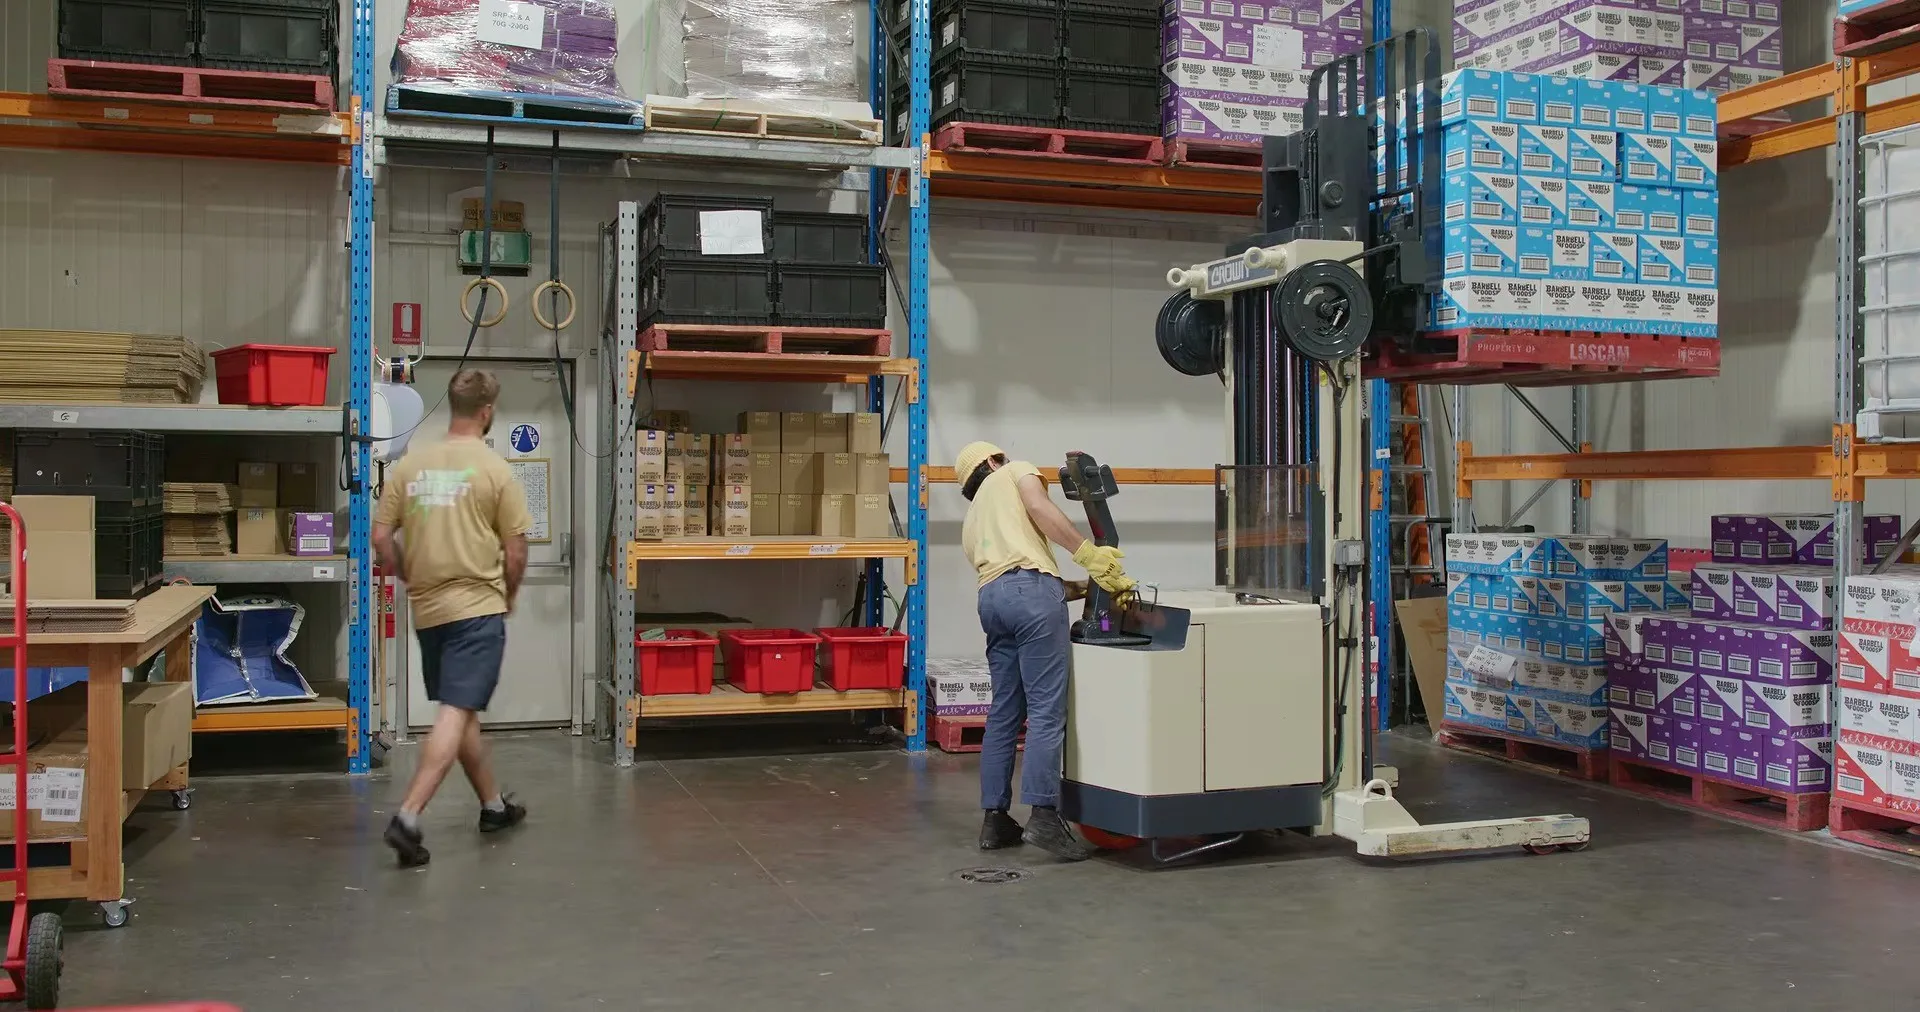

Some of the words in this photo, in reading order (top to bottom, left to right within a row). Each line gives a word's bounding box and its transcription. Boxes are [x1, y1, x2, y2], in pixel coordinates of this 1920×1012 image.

[1556, 236, 1585, 244] BARBELL
[1471, 282, 1501, 290] BARBELL
[1508, 283, 1537, 291] BARBELL
[1546, 285, 1575, 294] BARBELL
[1582, 287, 1611, 296] BARBELL
[1617, 289, 1646, 297] BARBELL
[1652, 290, 1680, 299] BARBELL
[1688, 293, 1715, 302] BARBELL
[1477, 343, 1521, 353] PROPERTY
[1570, 343, 1630, 361] LOSCAM
[1848, 585, 1876, 595] BARBELL
[1851, 593, 1874, 601] FOODS
[1859, 639, 1883, 649] BARBELL
[1862, 646, 1882, 654] FOODS
[1716, 680, 1738, 689] BARBELL
[1716, 681, 1738, 690] BARBELL
[1763, 687, 1786, 696] BARBELL
[1793, 692, 1820, 701] BARBELL
[1844, 697, 1873, 708] BARBELL
[1848, 704, 1872, 713] FOODS
[1880, 702, 1909, 714] BARBELL
[1884, 710, 1907, 719] FOODS
[1858, 751, 1883, 762] BARBELL
[1861, 758, 1881, 766] FOODS
